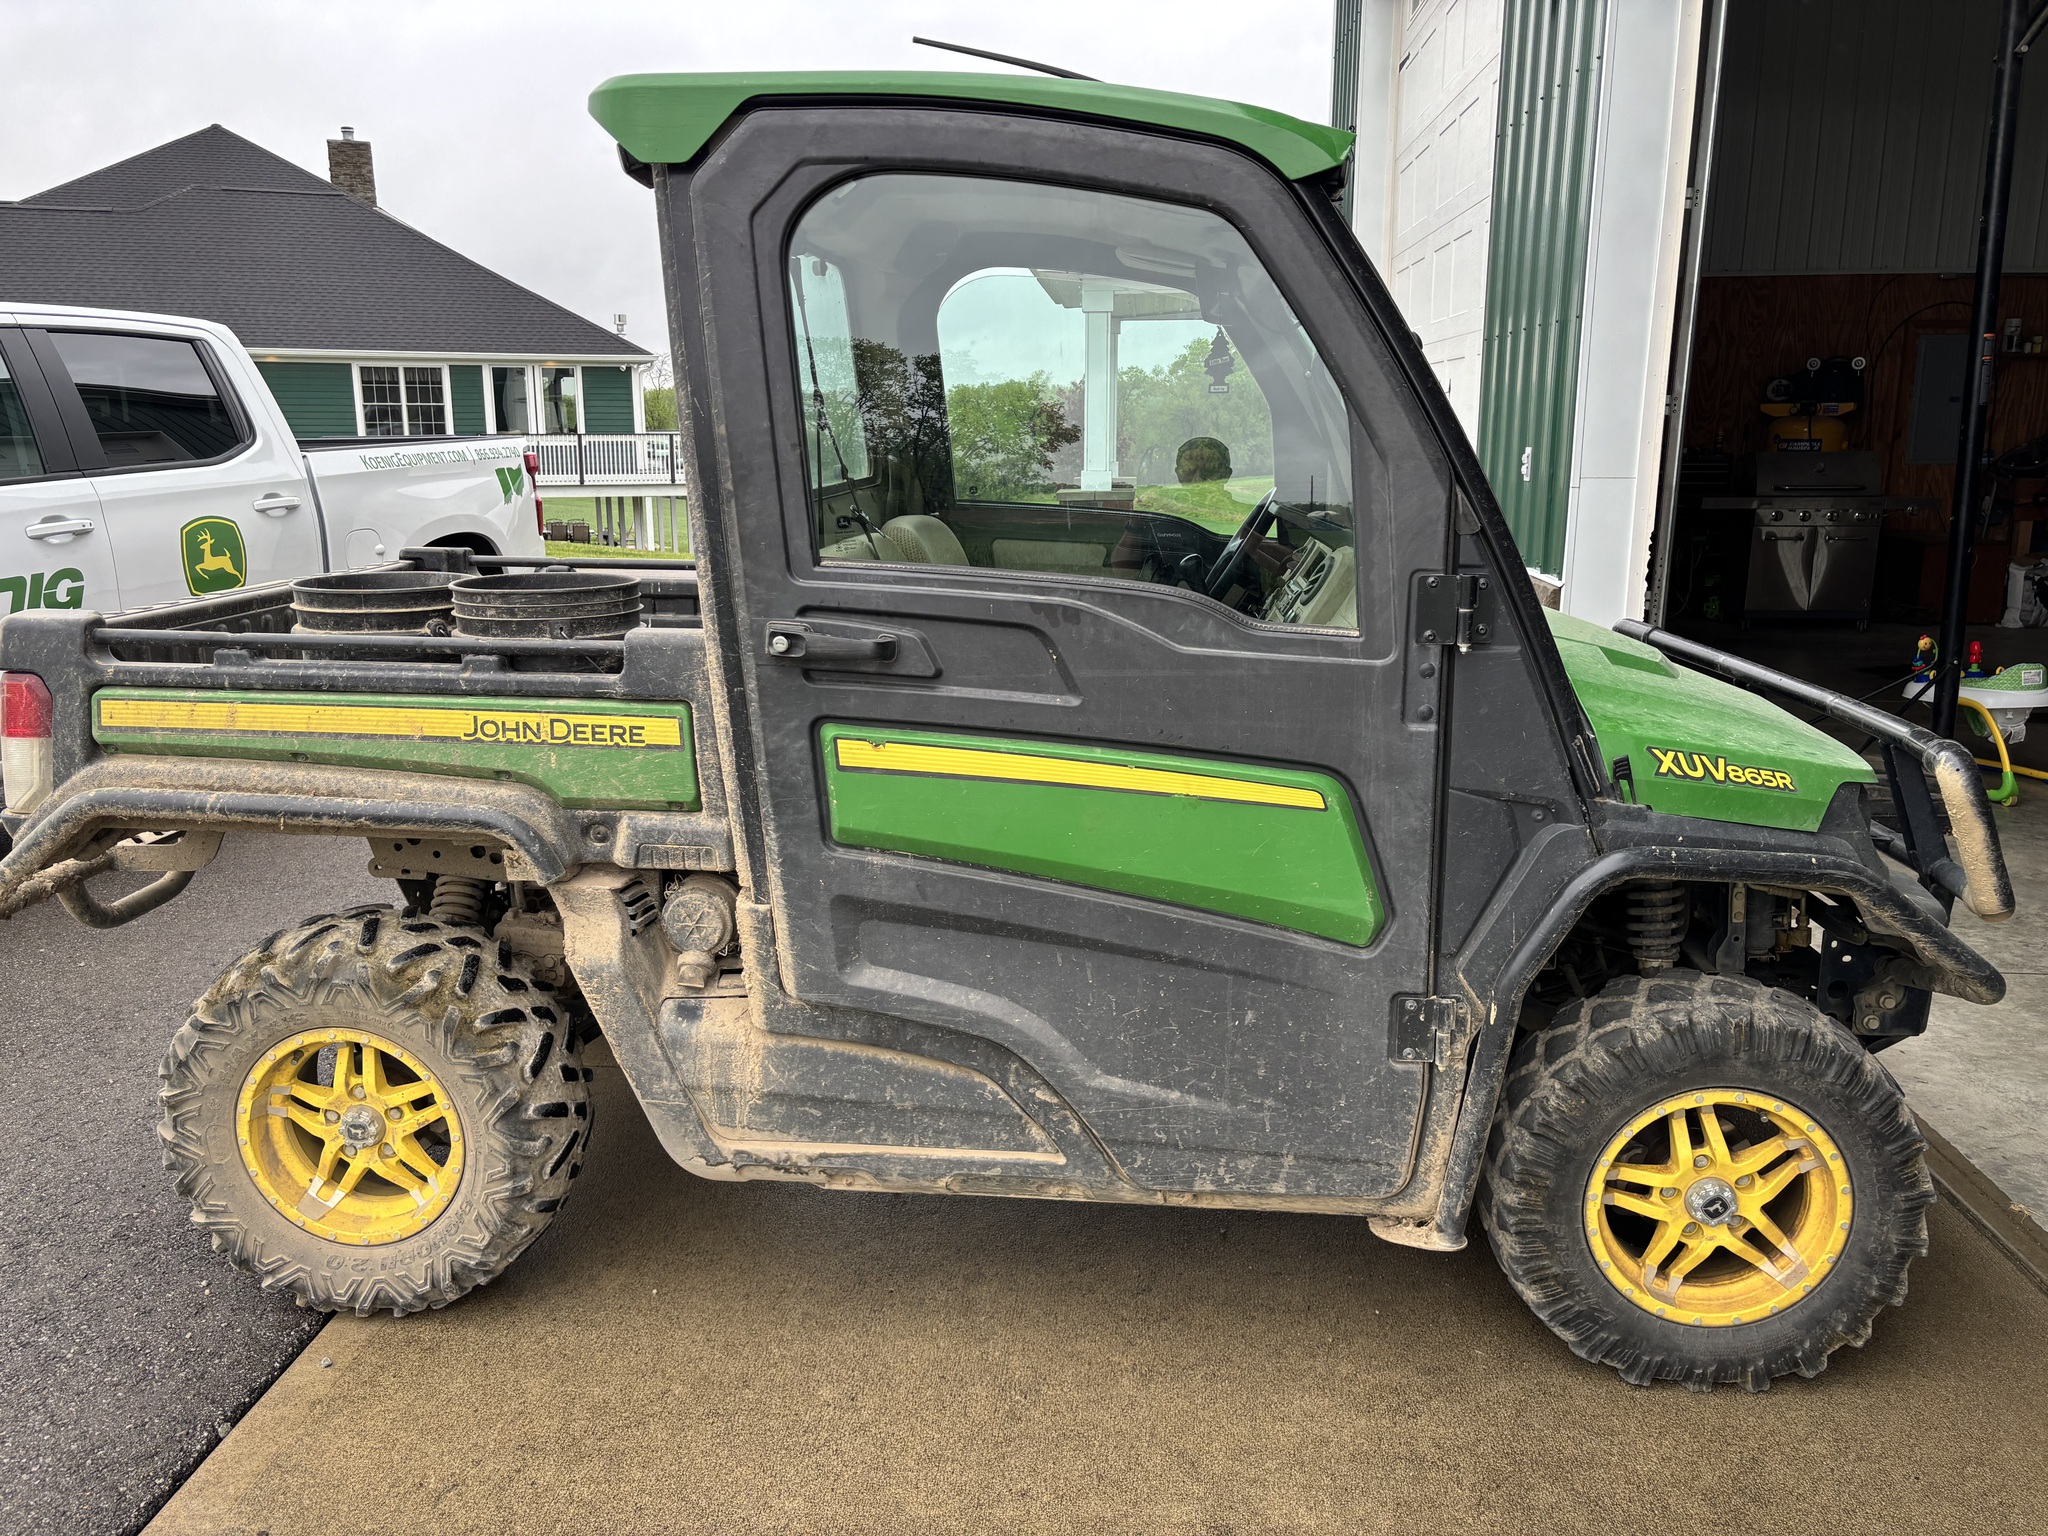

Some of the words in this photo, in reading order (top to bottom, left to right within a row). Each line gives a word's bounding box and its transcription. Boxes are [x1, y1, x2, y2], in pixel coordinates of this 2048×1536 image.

[463, 715, 541, 740] JOHN
[549, 718, 646, 744] DEERE
[1648, 747, 1797, 792] XUV865R
